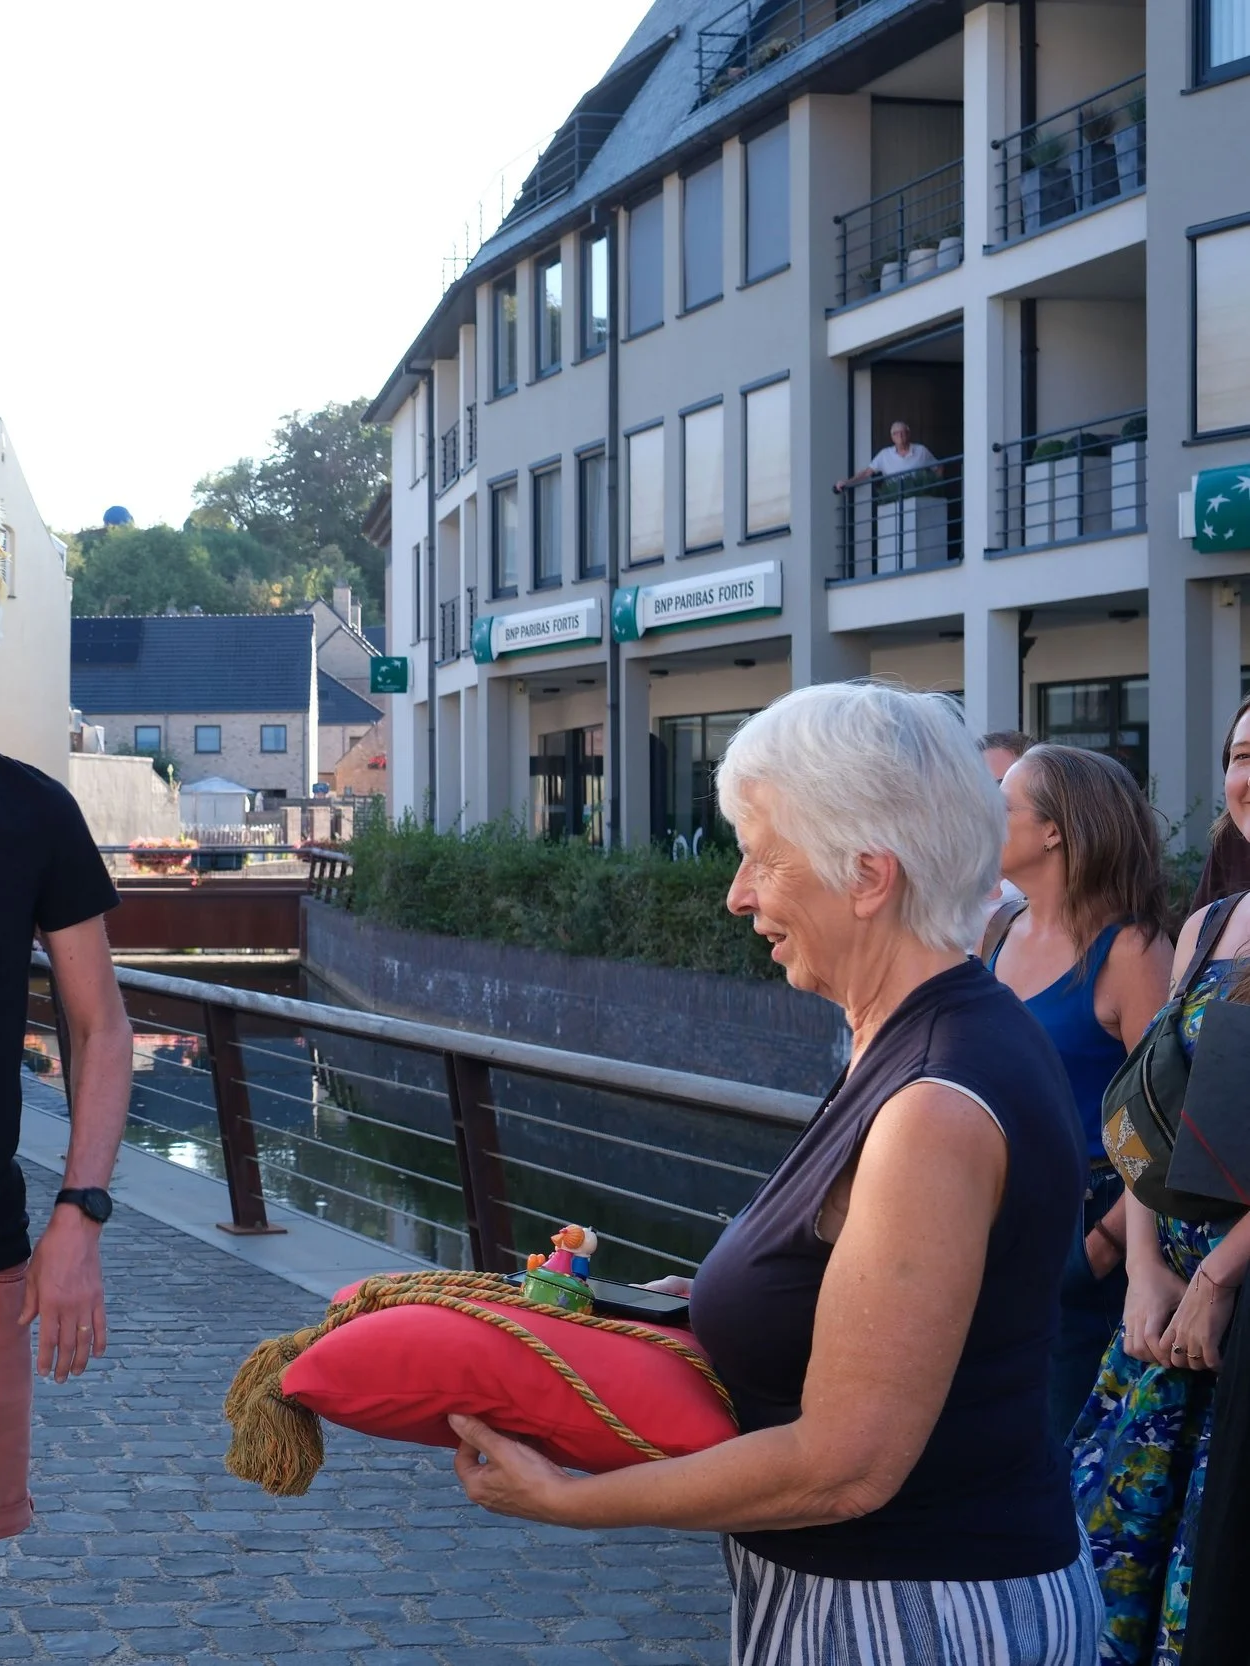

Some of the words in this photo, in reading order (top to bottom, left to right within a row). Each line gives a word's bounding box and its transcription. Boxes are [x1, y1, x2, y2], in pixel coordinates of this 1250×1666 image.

[654, 596, 673, 615] BNP
[674, 588, 715, 611] PARIBAS
[718, 580, 755, 603] FORTIS
[505, 627, 520, 641] BNP
[520, 620, 551, 639] PARIBAS
[553, 614, 580, 632] FORTIS
